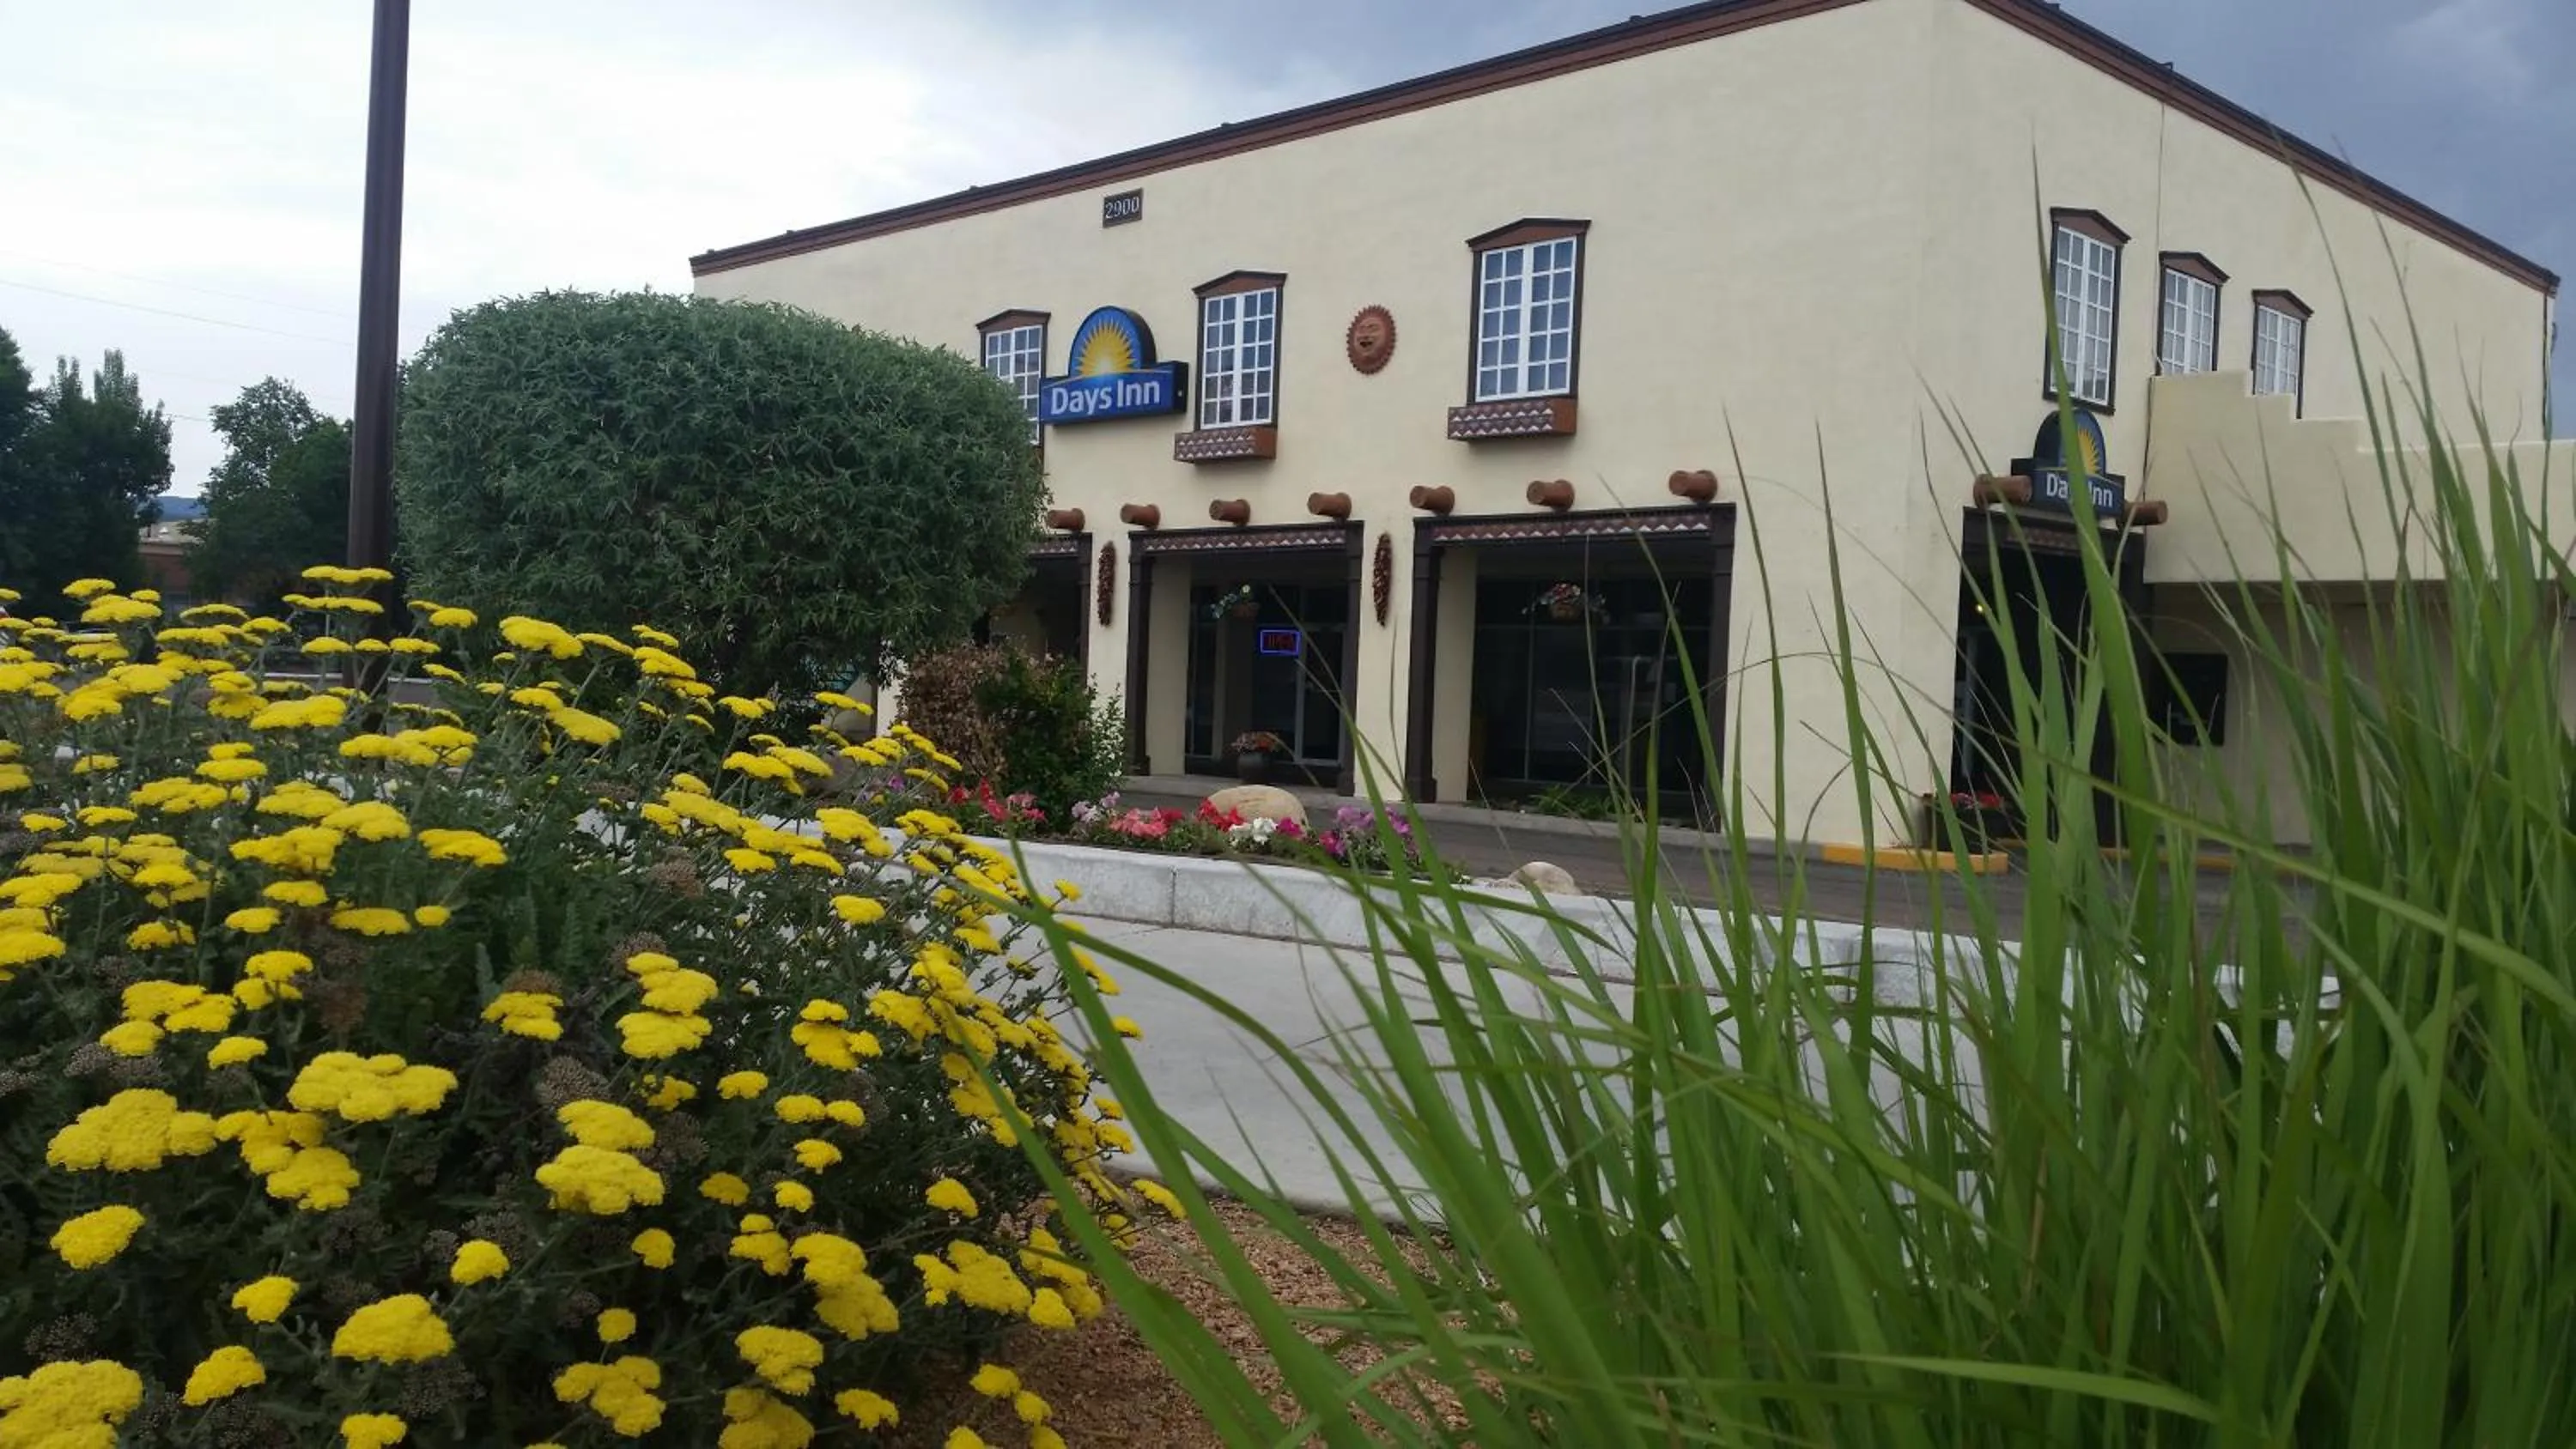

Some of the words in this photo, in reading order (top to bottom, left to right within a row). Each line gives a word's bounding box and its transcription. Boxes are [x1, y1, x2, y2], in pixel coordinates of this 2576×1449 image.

[1105, 196, 1139, 219] 2900
[1050, 386, 1111, 415] Days
[1116, 379, 1160, 408] Inn
[2046, 472, 2078, 502] Da
